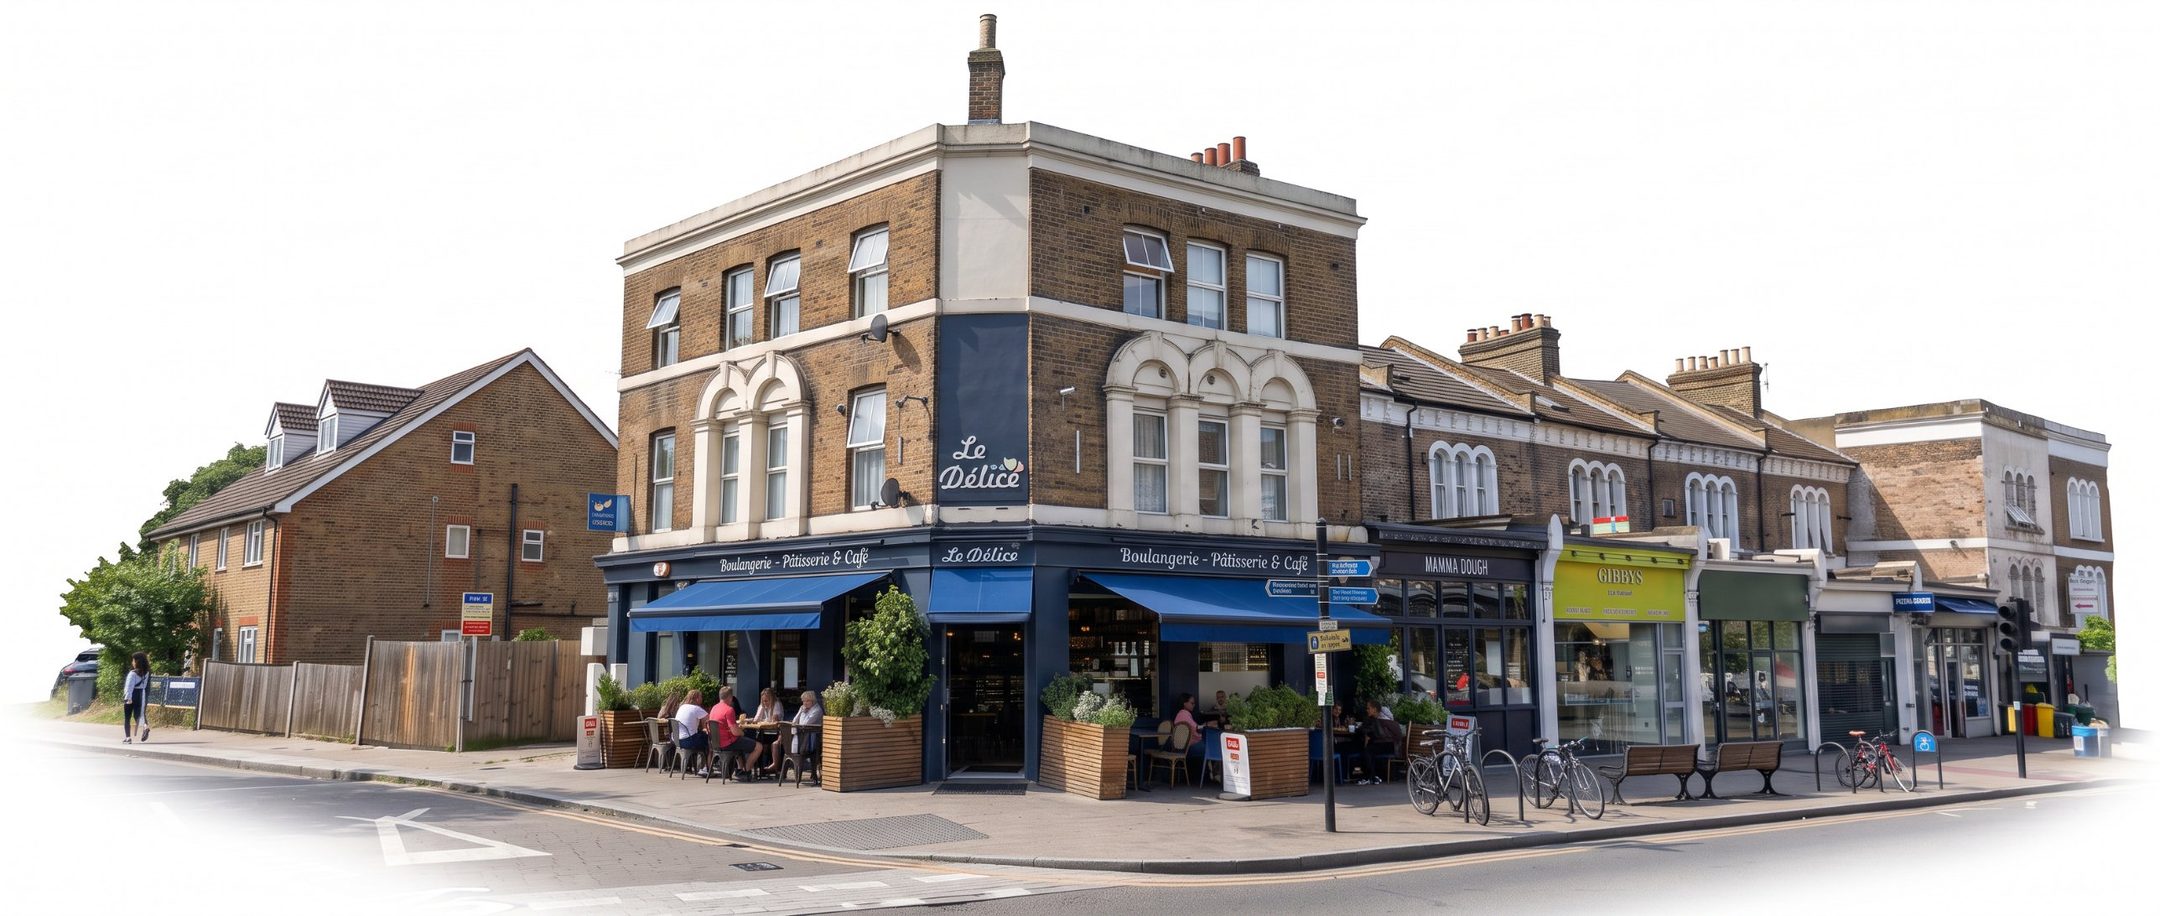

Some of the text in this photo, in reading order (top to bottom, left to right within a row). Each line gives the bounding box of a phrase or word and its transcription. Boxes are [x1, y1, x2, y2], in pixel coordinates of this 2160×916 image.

[952, 435, 986, 460] Le
[939, 464, 1020, 490] Délice
[719, 556, 772, 575] Boulangerie
[832, 550, 842, 566] &
[845, 547, 869, 569] Café
[941, 546, 1018, 563] Le Délice
[1120, 547, 1199, 570] Boulangerie
[1211, 552, 1268, 569] Pâtisserie
[1271, 554, 1280, 569] &
[1284, 555, 1308, 576] Café
[1425, 555, 1489, 576] MAMMA DOUGH
[1598, 567, 1644, 585] GIBBYS
